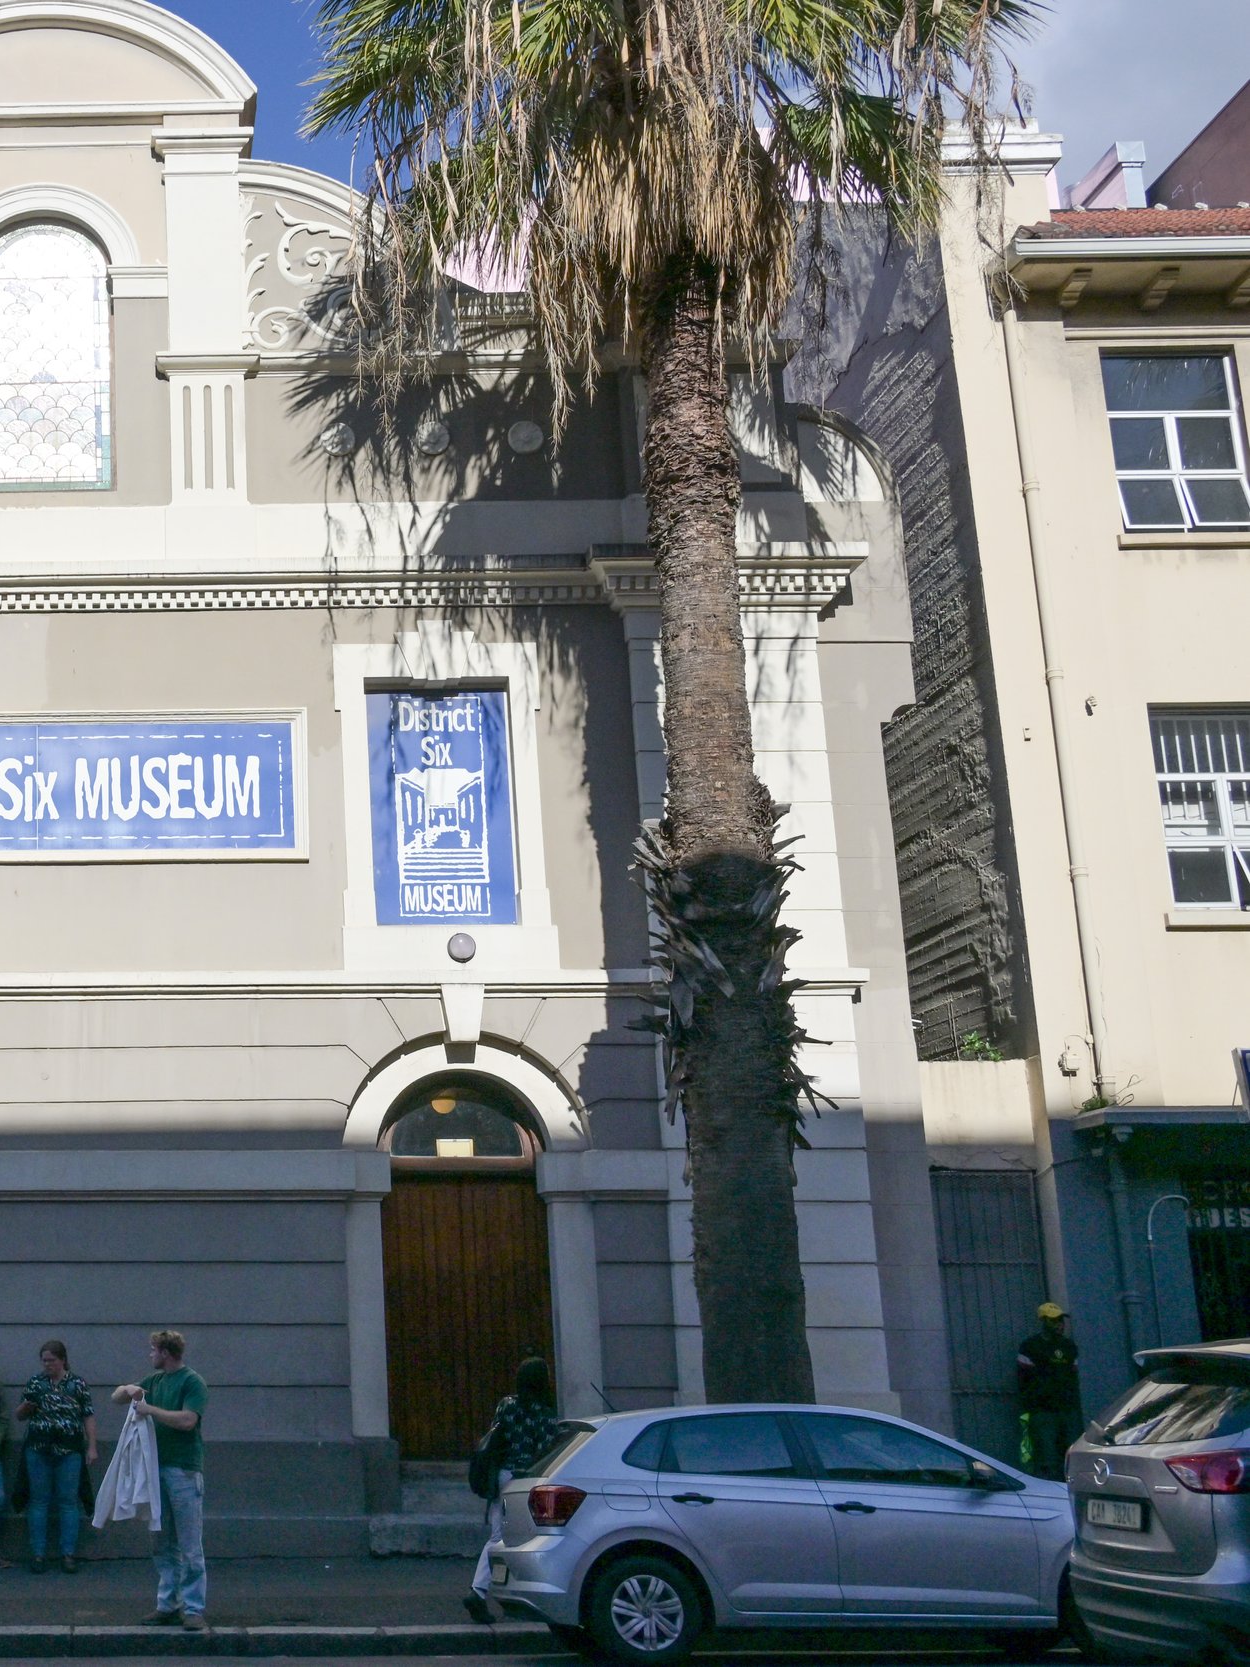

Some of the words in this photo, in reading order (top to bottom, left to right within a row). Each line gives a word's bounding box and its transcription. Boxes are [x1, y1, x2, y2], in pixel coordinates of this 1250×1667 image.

[397, 701, 476, 733] District
[420, 735, 453, 767] Six
[74, 752, 261, 821] MUSEUM
[403, 884, 482, 913] MUSEUM
